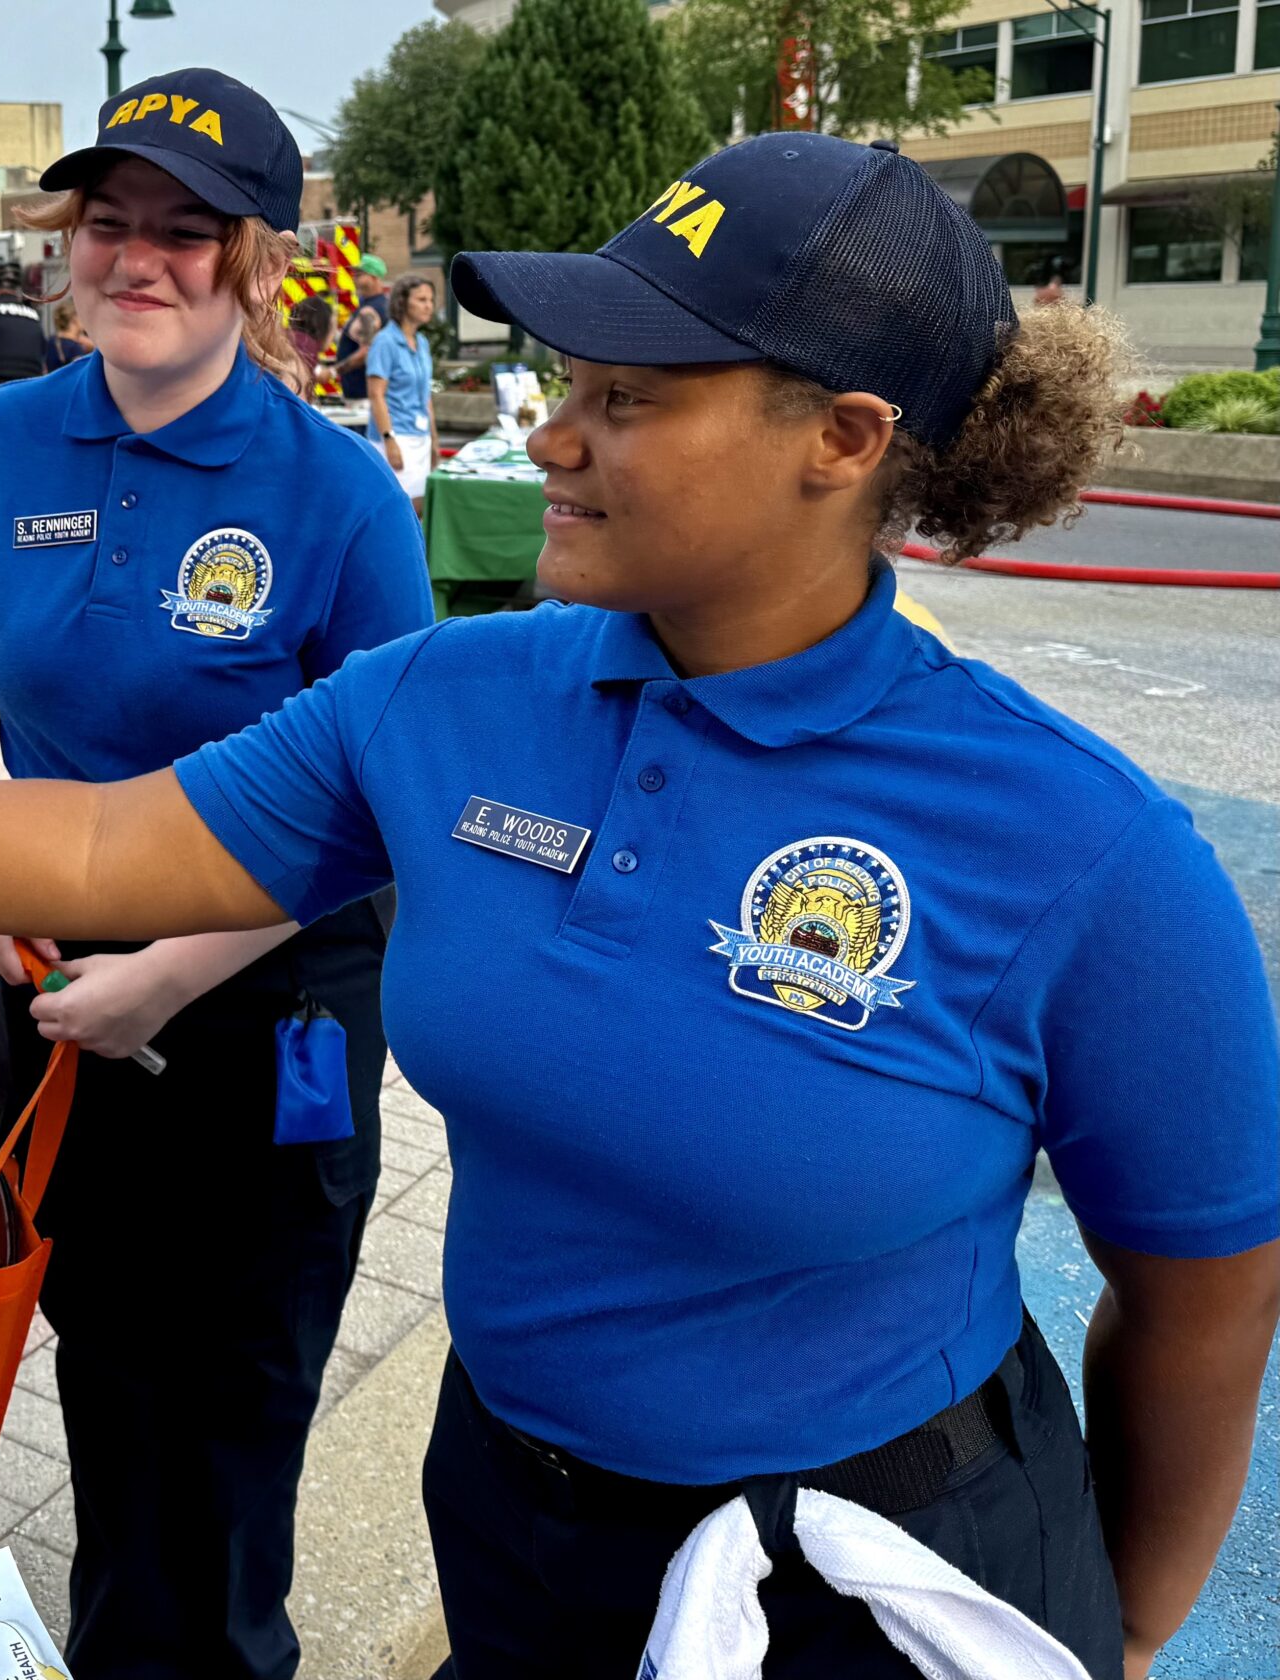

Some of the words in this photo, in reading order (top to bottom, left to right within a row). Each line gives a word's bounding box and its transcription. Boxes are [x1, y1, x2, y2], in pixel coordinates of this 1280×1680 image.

[105, 93, 223, 146] RPYA
[17, 522, 27, 535] S.
[32, 514, 92, 533] RENNINGER
[36, 532, 52, 541] POLICE
[54, 530, 69, 539] YOUTH
[70, 528, 91, 537] ACADEMY
[176, 601, 212, 612] YOUTH
[211, 603, 255, 626] ACADEMY
[461, 821, 488, 837] READING
[488, 830, 513, 846] POLICE
[513, 838, 537, 852] YOUTH
[537, 845, 570, 862] ACADEMY
[475, 806, 492, 826] E.
[502, 813, 568, 848] WOODS
[784, 862, 810, 883] CITY
[813, 858, 832, 868] OF
[833, 858, 881, 903] READING
[807, 875, 858, 898] POLICE
[738, 946, 797, 965] YOUTH
[797, 954, 878, 1004] ACADEMY
[789, 991, 806, 1006] PA
